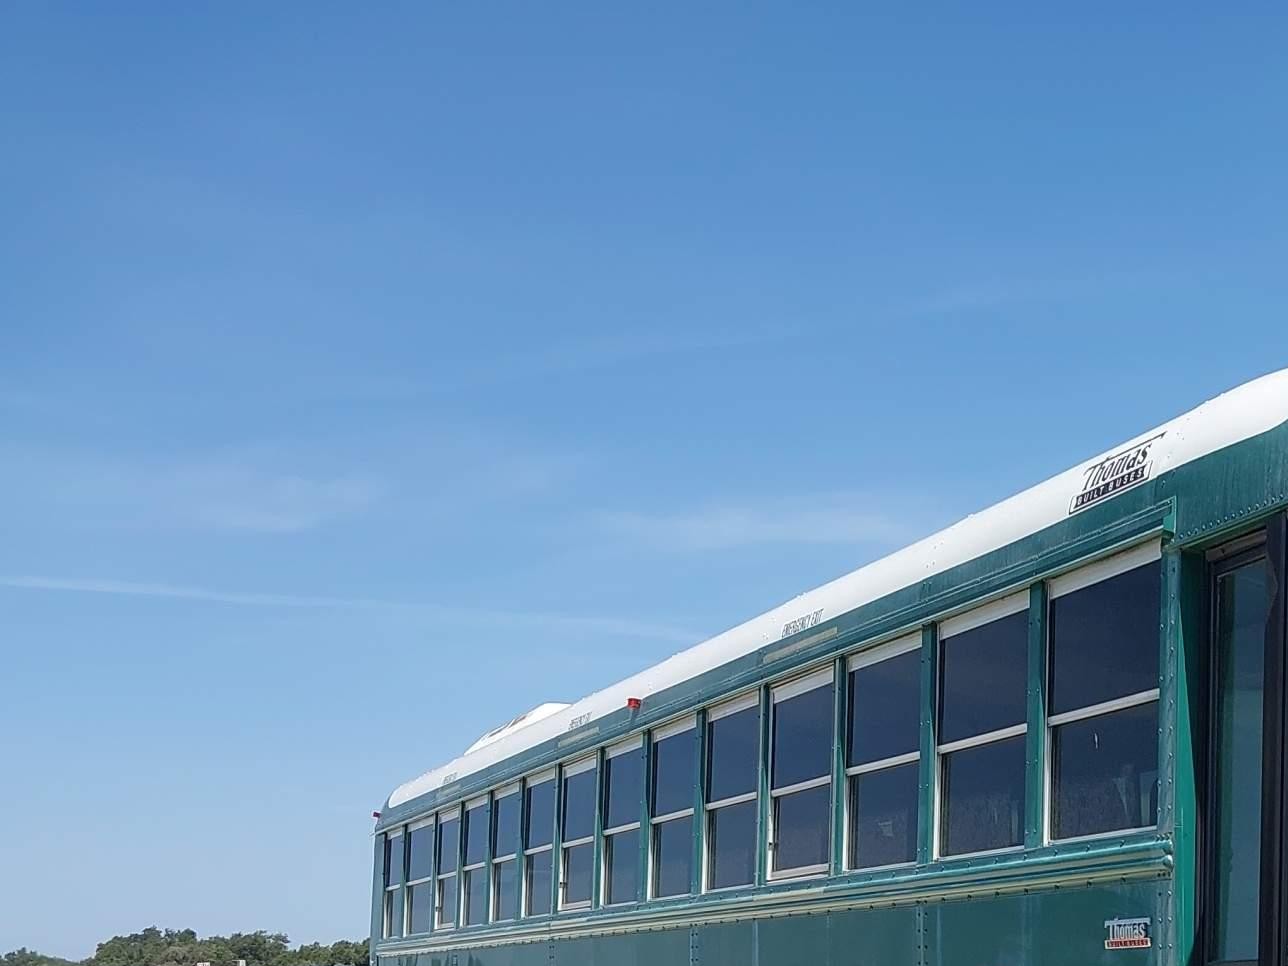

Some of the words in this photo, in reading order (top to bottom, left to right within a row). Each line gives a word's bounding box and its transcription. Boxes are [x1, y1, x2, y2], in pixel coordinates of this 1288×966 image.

[1081, 431, 1168, 492] Thomas
[1076, 484, 1107, 506] BUILT
[1107, 466, 1145, 491] BUSES
[1104, 916, 1151, 941] Thomas
